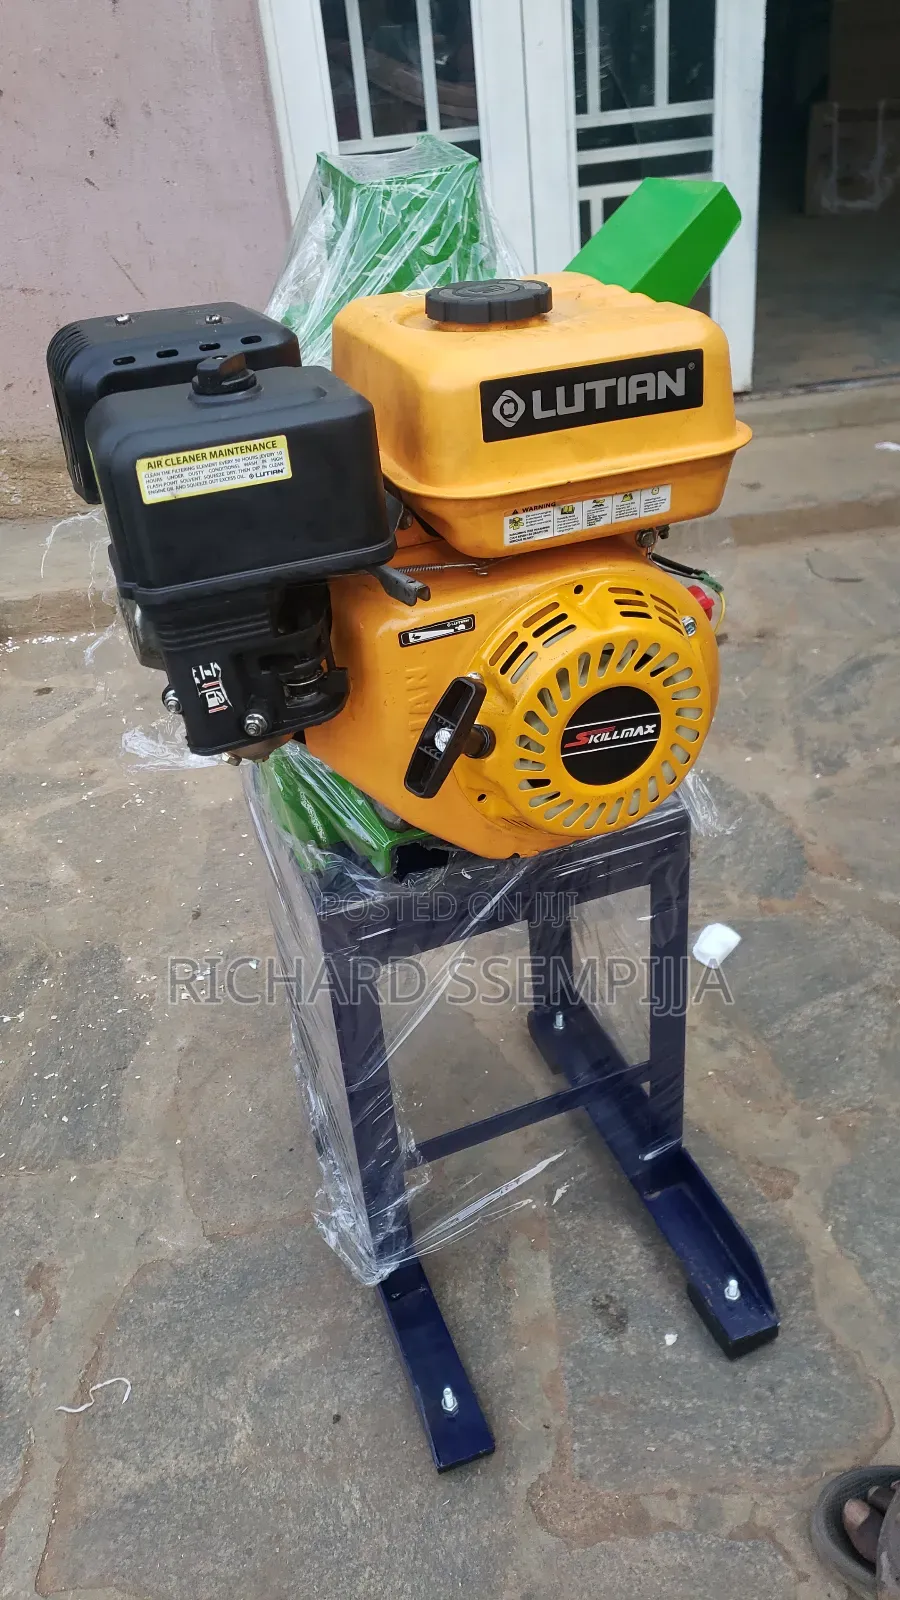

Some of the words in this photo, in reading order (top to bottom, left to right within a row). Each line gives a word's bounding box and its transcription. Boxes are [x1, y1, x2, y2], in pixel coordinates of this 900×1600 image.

[531, 367, 686, 420] LUTIAN
[147, 460, 163, 470] AIR
[165, 453, 207, 467] CLEANER
[209, 440, 277, 459] MAINTENANCE
[197, 462, 218, 470] ELEMENT
[522, 502, 556, 513] WARNING
[563, 723, 657, 749] SKILLMAX
